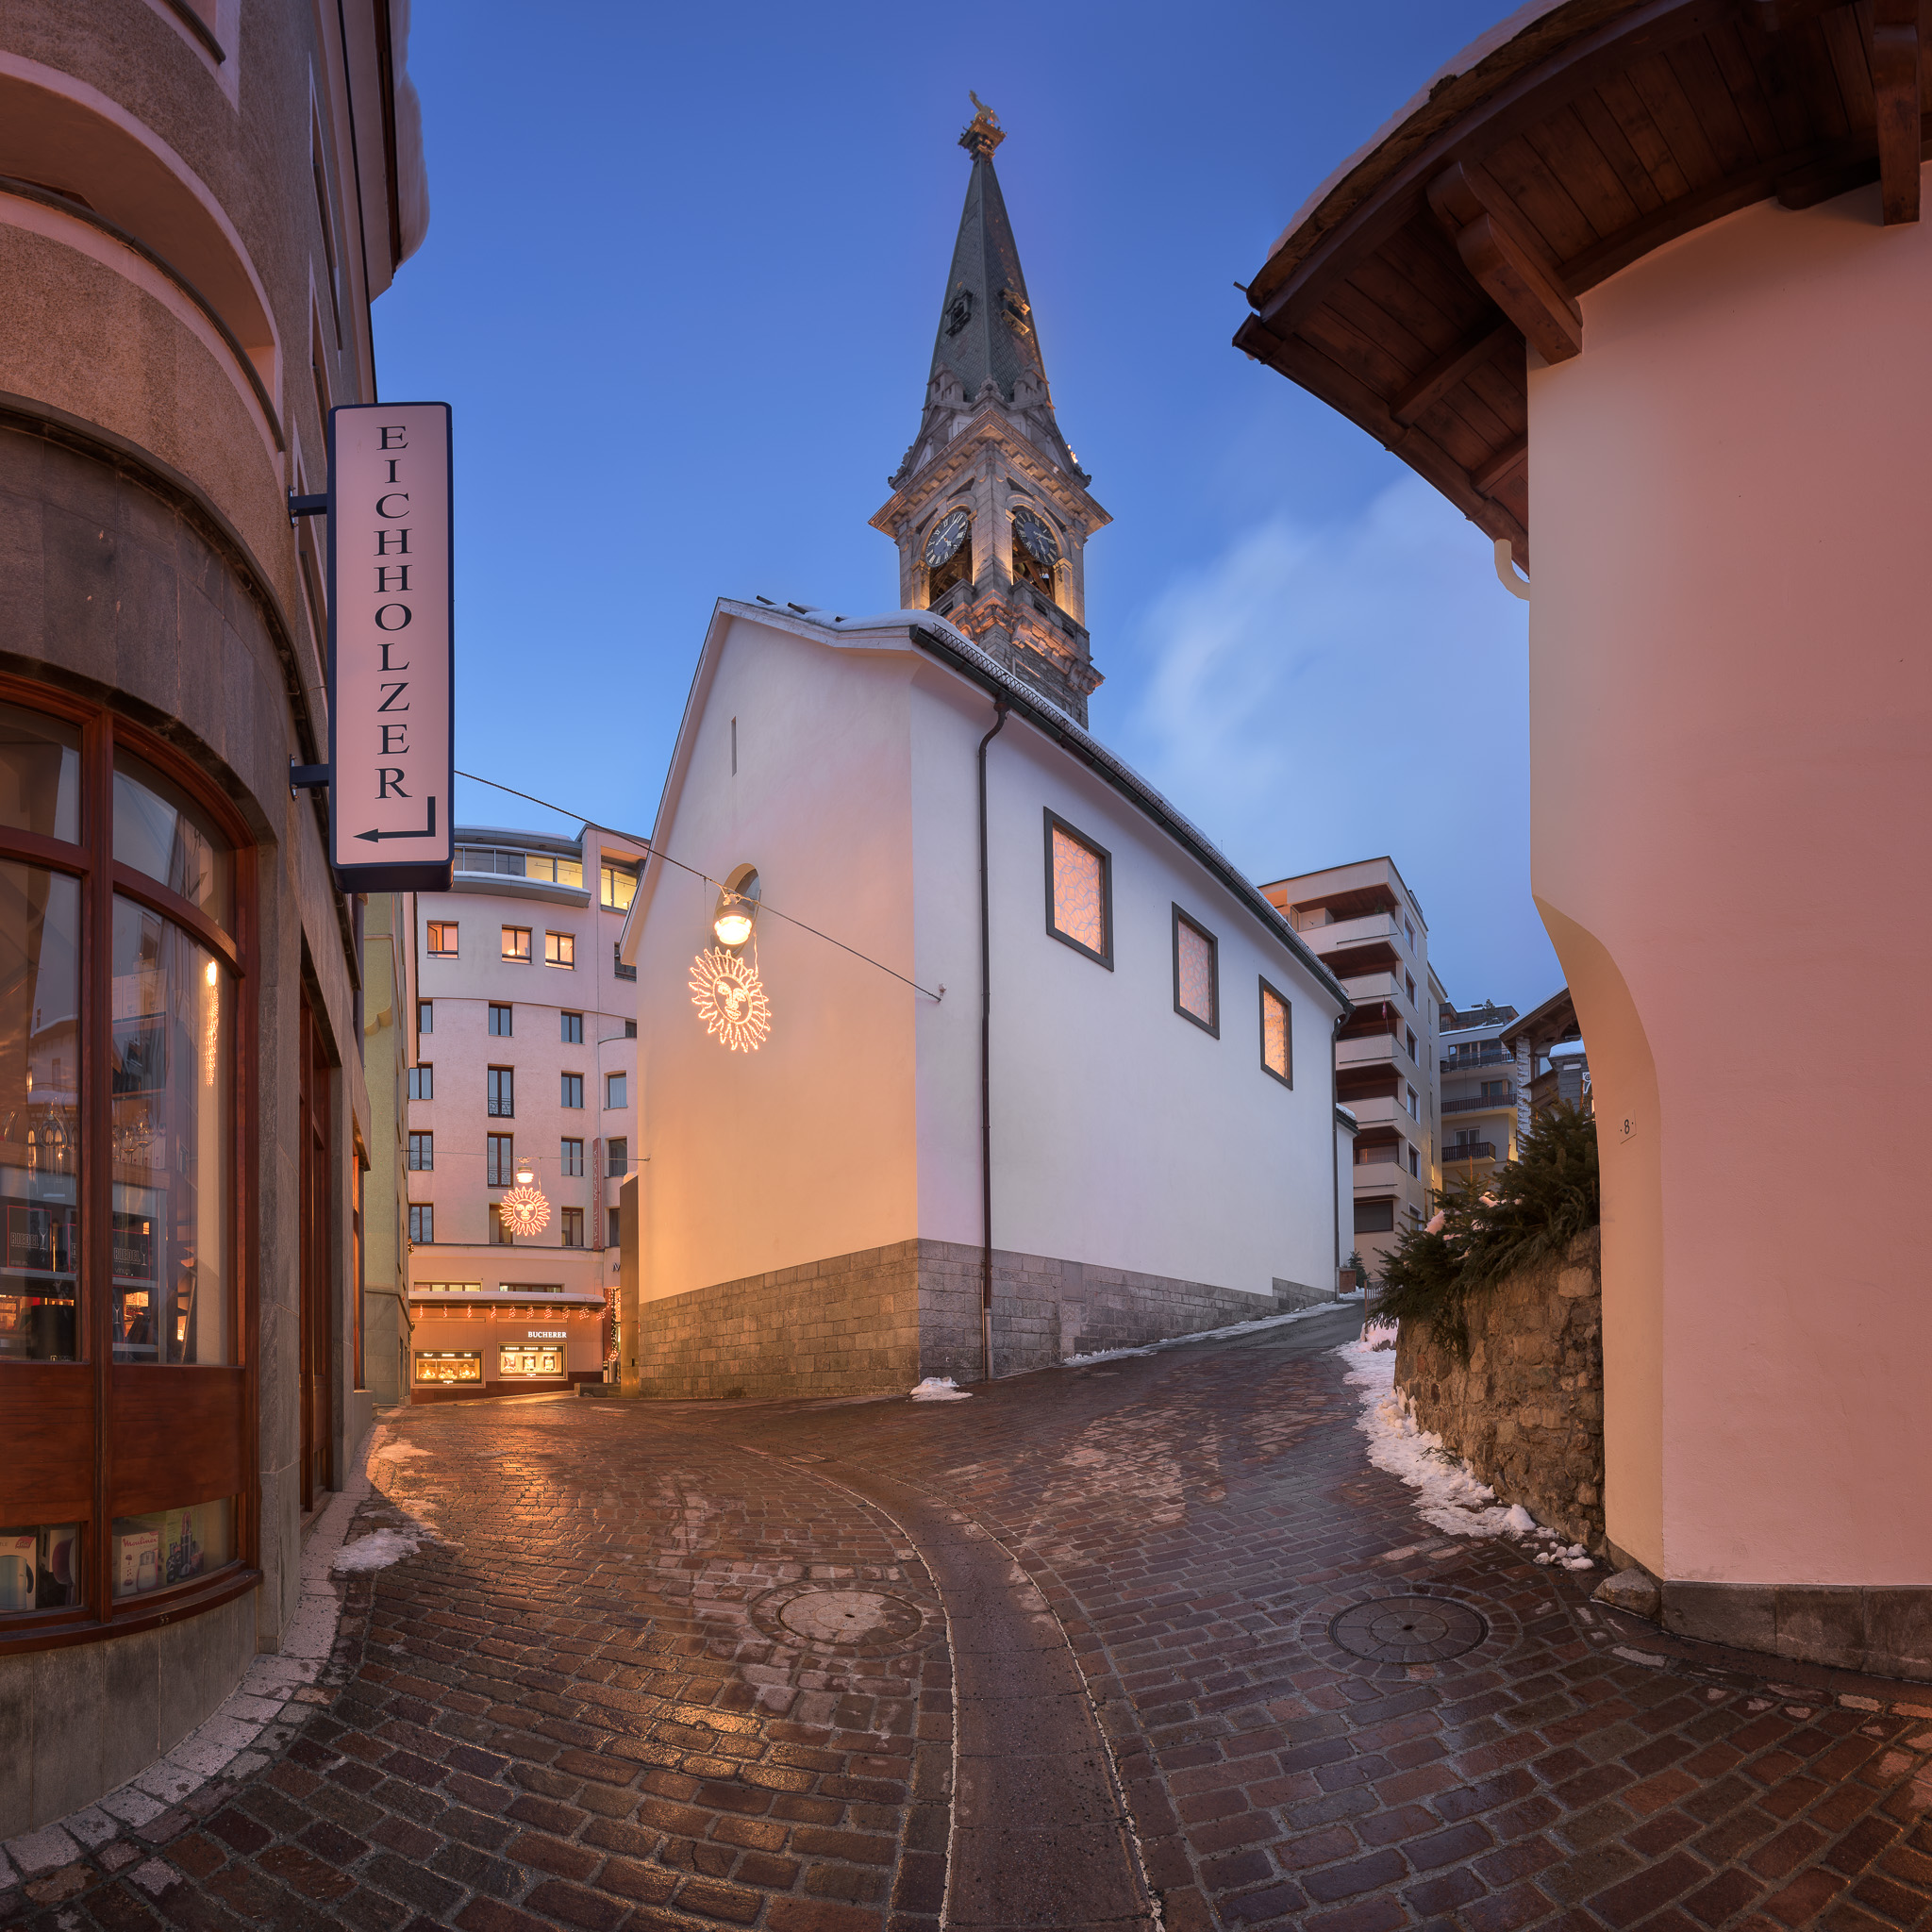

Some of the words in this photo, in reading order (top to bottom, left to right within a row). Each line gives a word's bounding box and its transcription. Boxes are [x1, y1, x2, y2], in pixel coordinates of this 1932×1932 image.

[374, 425, 413, 800] EICHHOLZER
[1624, 1119, 1630, 1135] 8
[9, 1231, 40, 1246] RIEDEL
[113, 1247, 141, 1261] RIEDEL
[527, 1330, 568, 1339] BUCHERER
[122, 1536, 158, 1548] Moulinex
